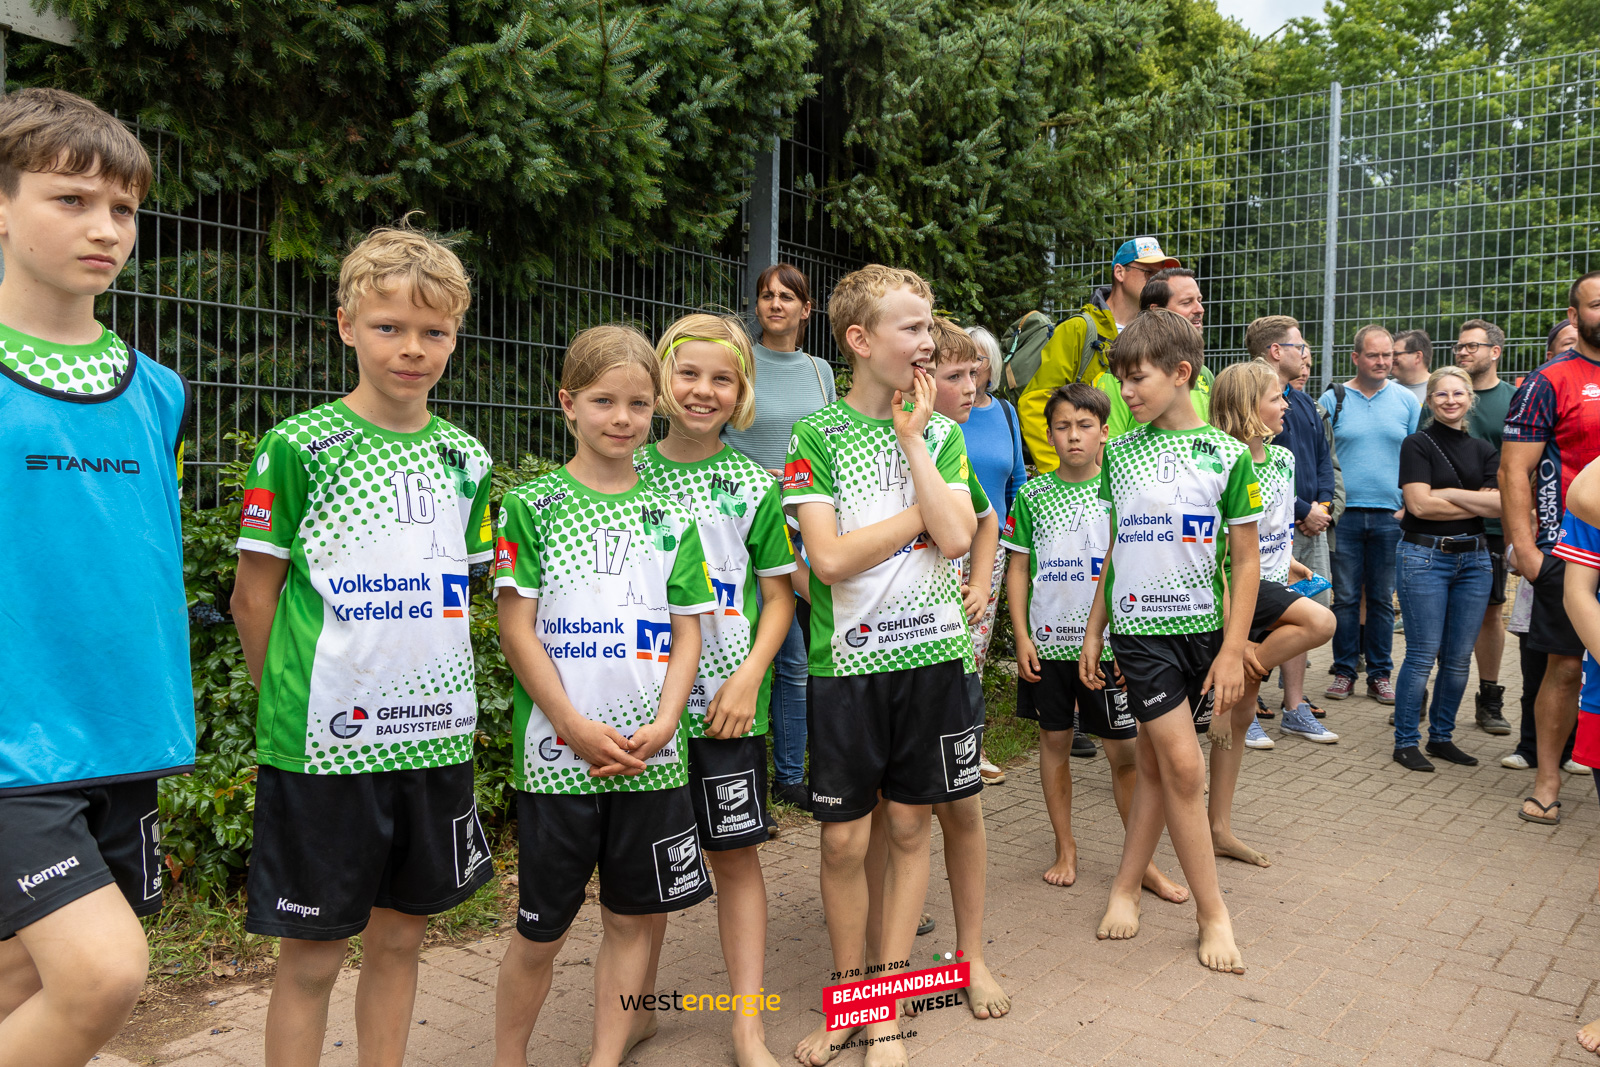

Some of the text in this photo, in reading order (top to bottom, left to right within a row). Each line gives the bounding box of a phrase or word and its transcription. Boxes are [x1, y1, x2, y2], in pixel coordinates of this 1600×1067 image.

[307, 430, 355, 455] Kempa
[1192, 438, 1217, 456] HSV
[25, 453, 141, 475] STANNO
[436, 446, 467, 470] HSV
[1156, 451, 1176, 484] 6
[874, 449, 908, 492] 14
[711, 473, 740, 497] HSV
[1027, 484, 1053, 499] Kempa
[388, 470, 436, 525] 16
[247, 503, 272, 523] May
[641, 505, 666, 526] HSV
[1069, 503, 1085, 532] 7
[1547, 480, 1560, 541] COLONIA
[1118, 530, 1174, 543] Krefeld eG
[591, 528, 632, 576] 17
[329, 573, 431, 596] Volksbank
[1070, 571, 1085, 582] eG
[1141, 593, 1191, 603] GEHLINGS
[1141, 602, 1213, 612] BAUSYSTEME GMBH
[332, 601, 433, 622] Krefeld eG
[542, 617, 625, 635] Volksbank
[877, 613, 936, 633] GEHLINGS
[878, 621, 962, 644] BAUSYSTEME GMBH
[1055, 626, 1087, 634] GEHLIN
[602, 643, 626, 659] eG
[1142, 691, 1168, 708] Kempa
[376, 702, 453, 721] GEHLINGS
[376, 719, 452, 736] BAUSYSTEME
[812, 791, 842, 807] Kempa
[716, 818, 757, 833] Stratmans
[721, 812, 750, 824] Johann
[17, 855, 80, 893] Kempa
[276, 897, 321, 918] Kempa
